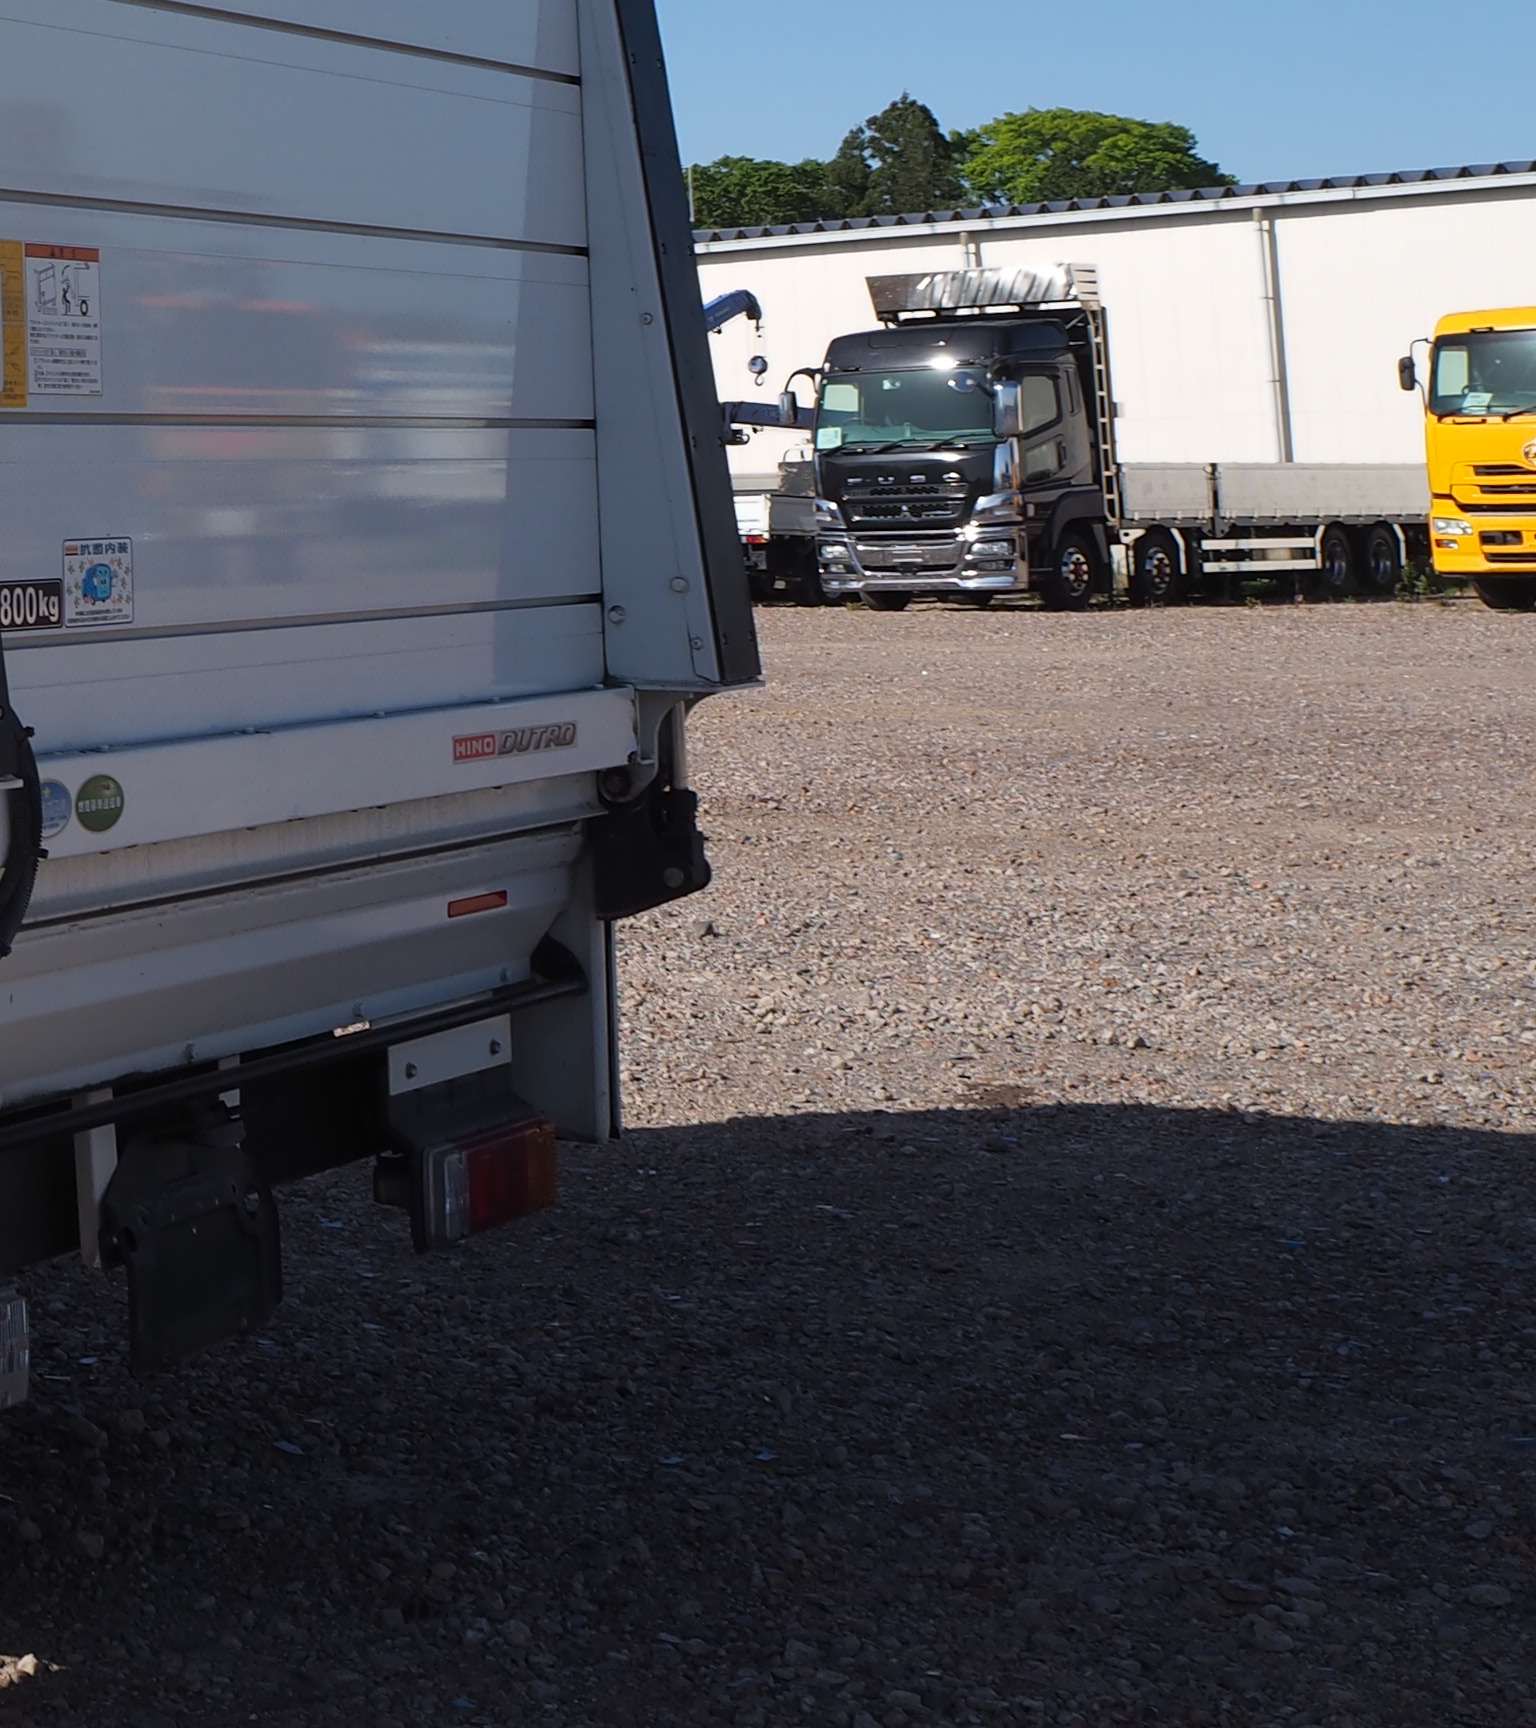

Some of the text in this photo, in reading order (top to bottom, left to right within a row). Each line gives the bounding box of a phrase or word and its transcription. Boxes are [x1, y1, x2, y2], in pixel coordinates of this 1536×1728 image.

[0, 587, 59, 626] 800kg
[455, 723, 576, 757] HINO DUTRO
